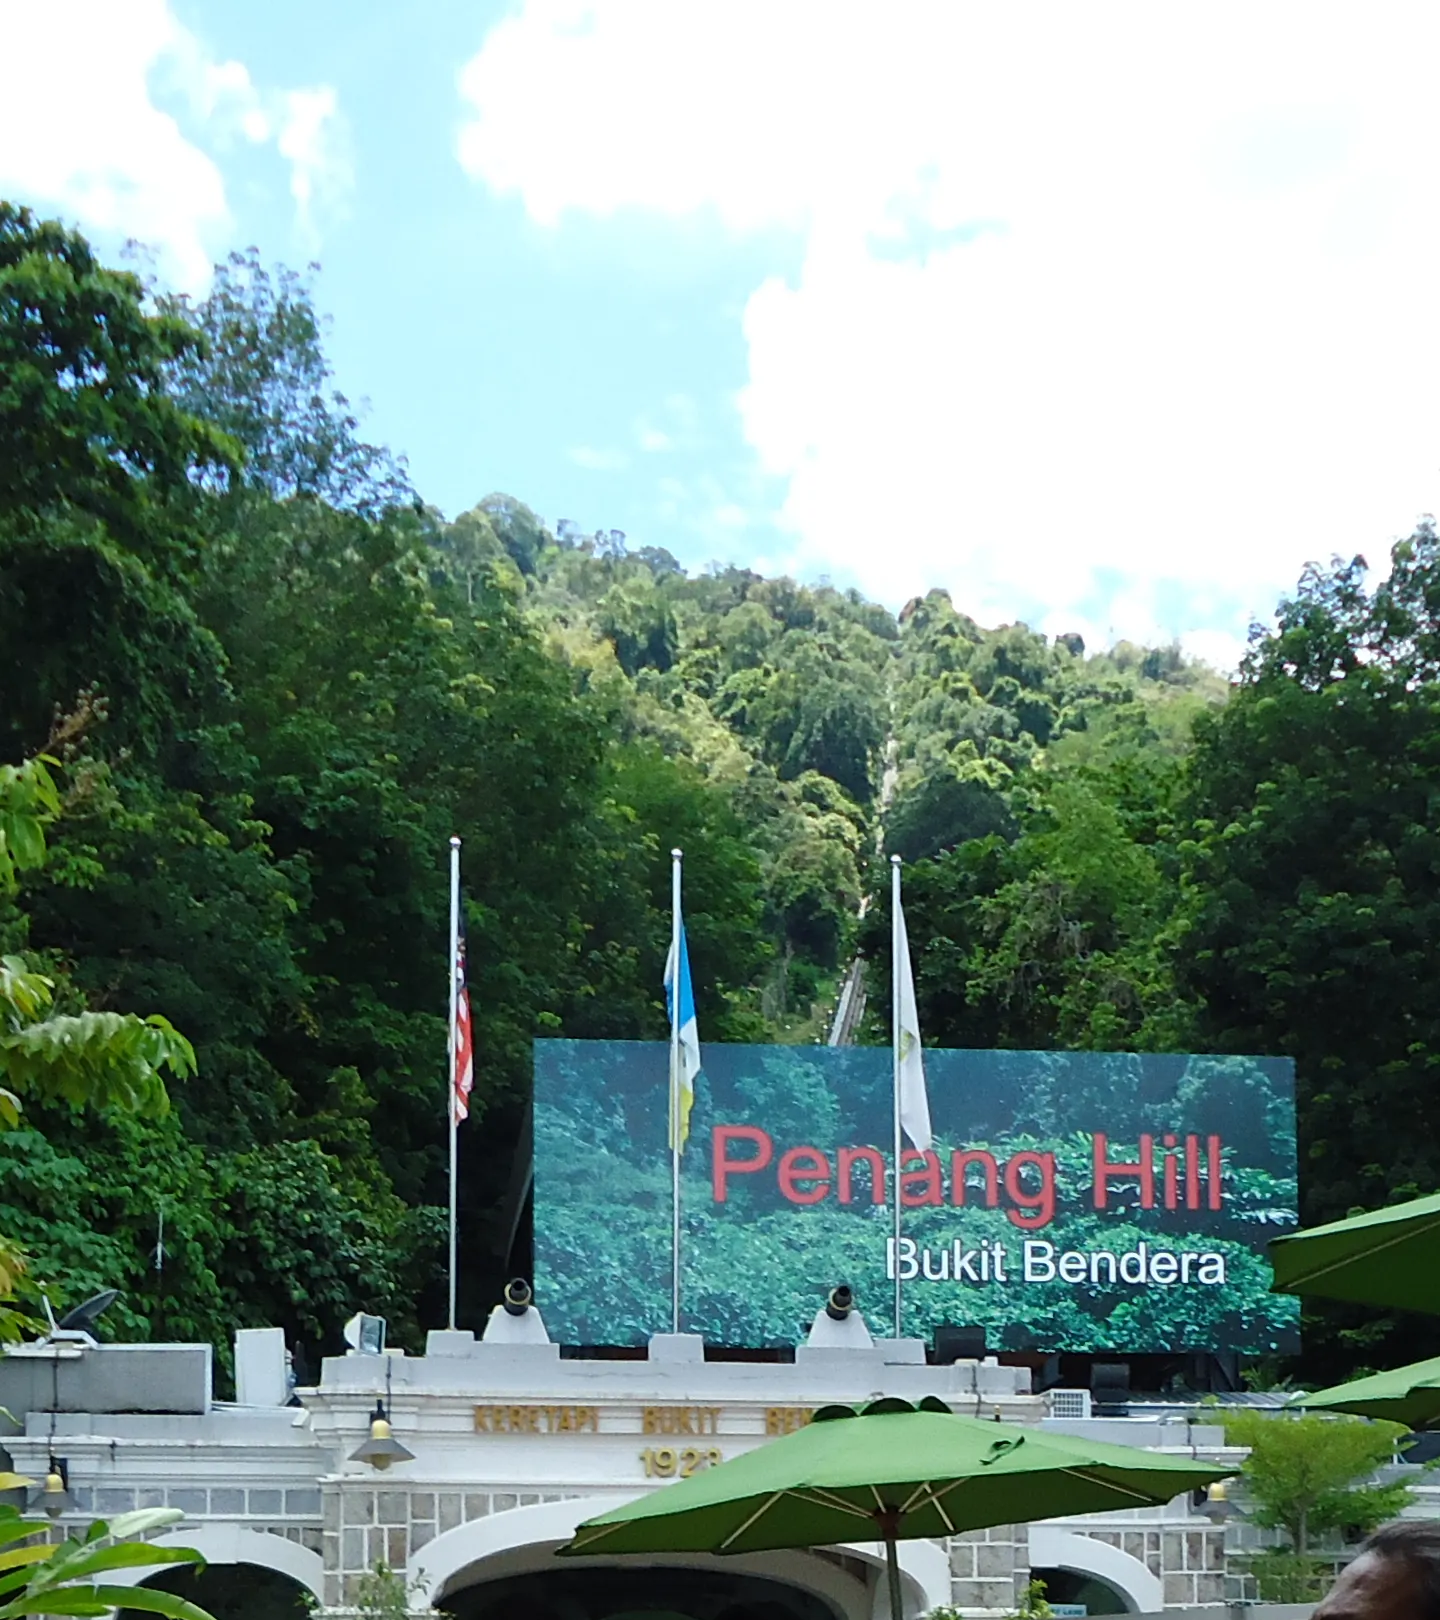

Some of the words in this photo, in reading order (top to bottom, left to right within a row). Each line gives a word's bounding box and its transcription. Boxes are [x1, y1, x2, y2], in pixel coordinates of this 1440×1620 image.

[711, 1125, 1057, 1229] Penang
[1091, 1132, 1222, 1212] Hill
[885, 1236, 1007, 1283] Bukit
[1022, 1239, 1227, 1286] Bendera
[474, 1404, 599, 1435] KERETAPI
[642, 1405, 721, 1436] BUKIT
[765, 1406, 814, 1436] BEN
